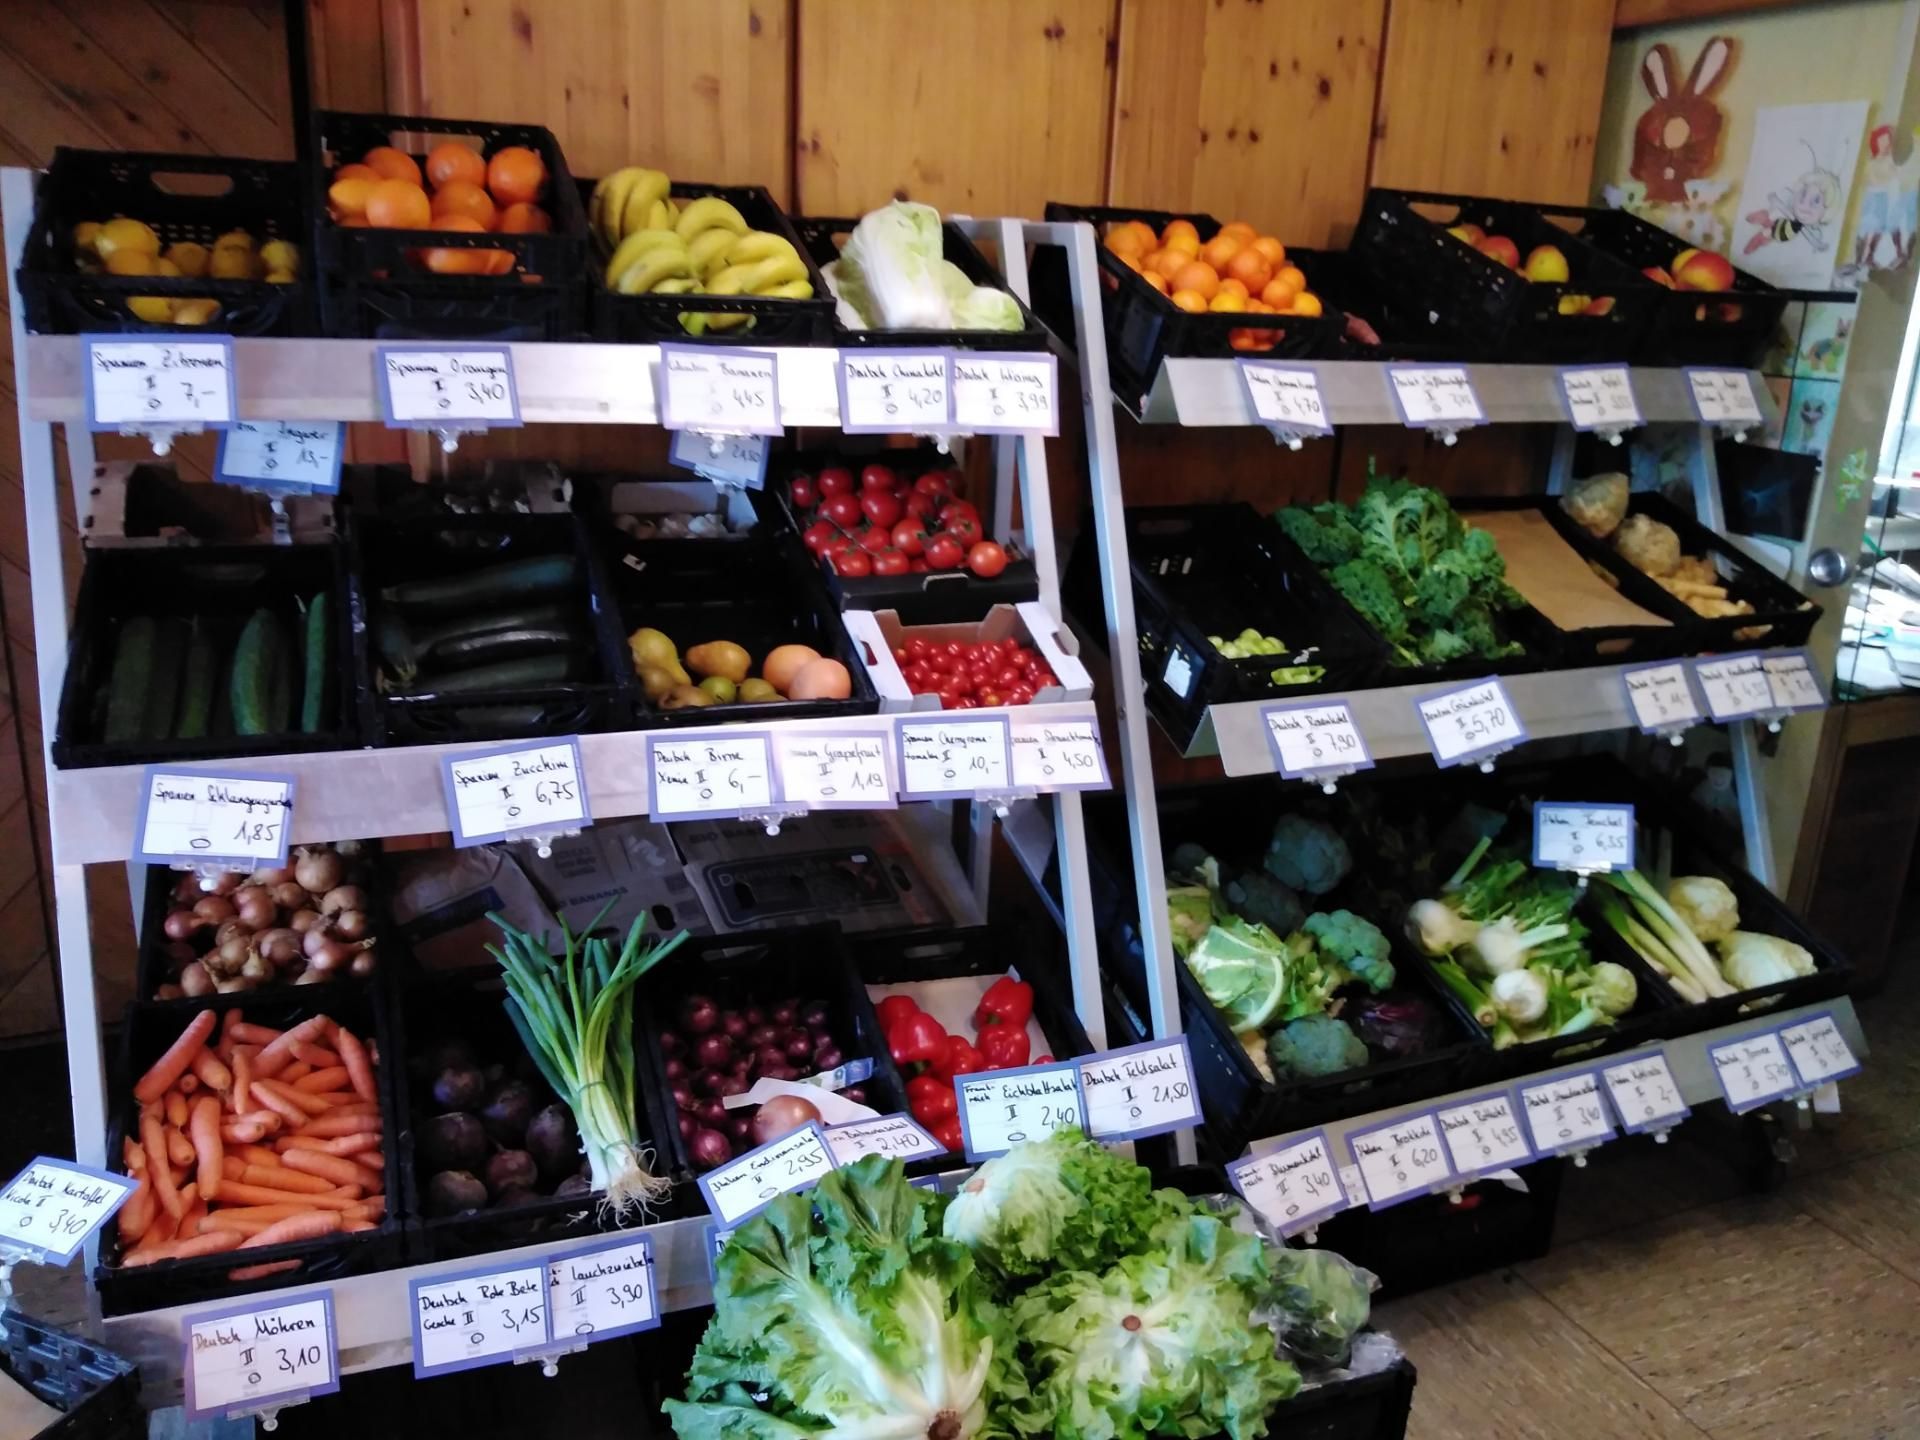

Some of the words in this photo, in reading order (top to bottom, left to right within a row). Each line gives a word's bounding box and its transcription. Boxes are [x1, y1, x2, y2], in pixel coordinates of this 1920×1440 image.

[704, 747, 744, 763] Birne
[535, 780, 576, 806] 6,75
[232, 821, 281, 847] 1,85
[1121, 1053, 1177, 1077] Feldsalat
[1041, 1105, 1075, 1130] 2,40
[874, 1133, 921, 1152] 2,40
[783, 1147, 824, 1177] 2,95
[49, 1208, 89, 1236] 3,40
[418, 1291, 469, 1311] Deutsch
[477, 1283, 506, 1302] Rote
[508, 1281, 539, 1298] Bete
[605, 1284, 644, 1310] 3,90
[500, 1304, 546, 1333] 3,15
[191, 1327, 242, 1350] Deutsch
[253, 1316, 317, 1339] Möhren
[275, 1346, 322, 1374] 3,10
